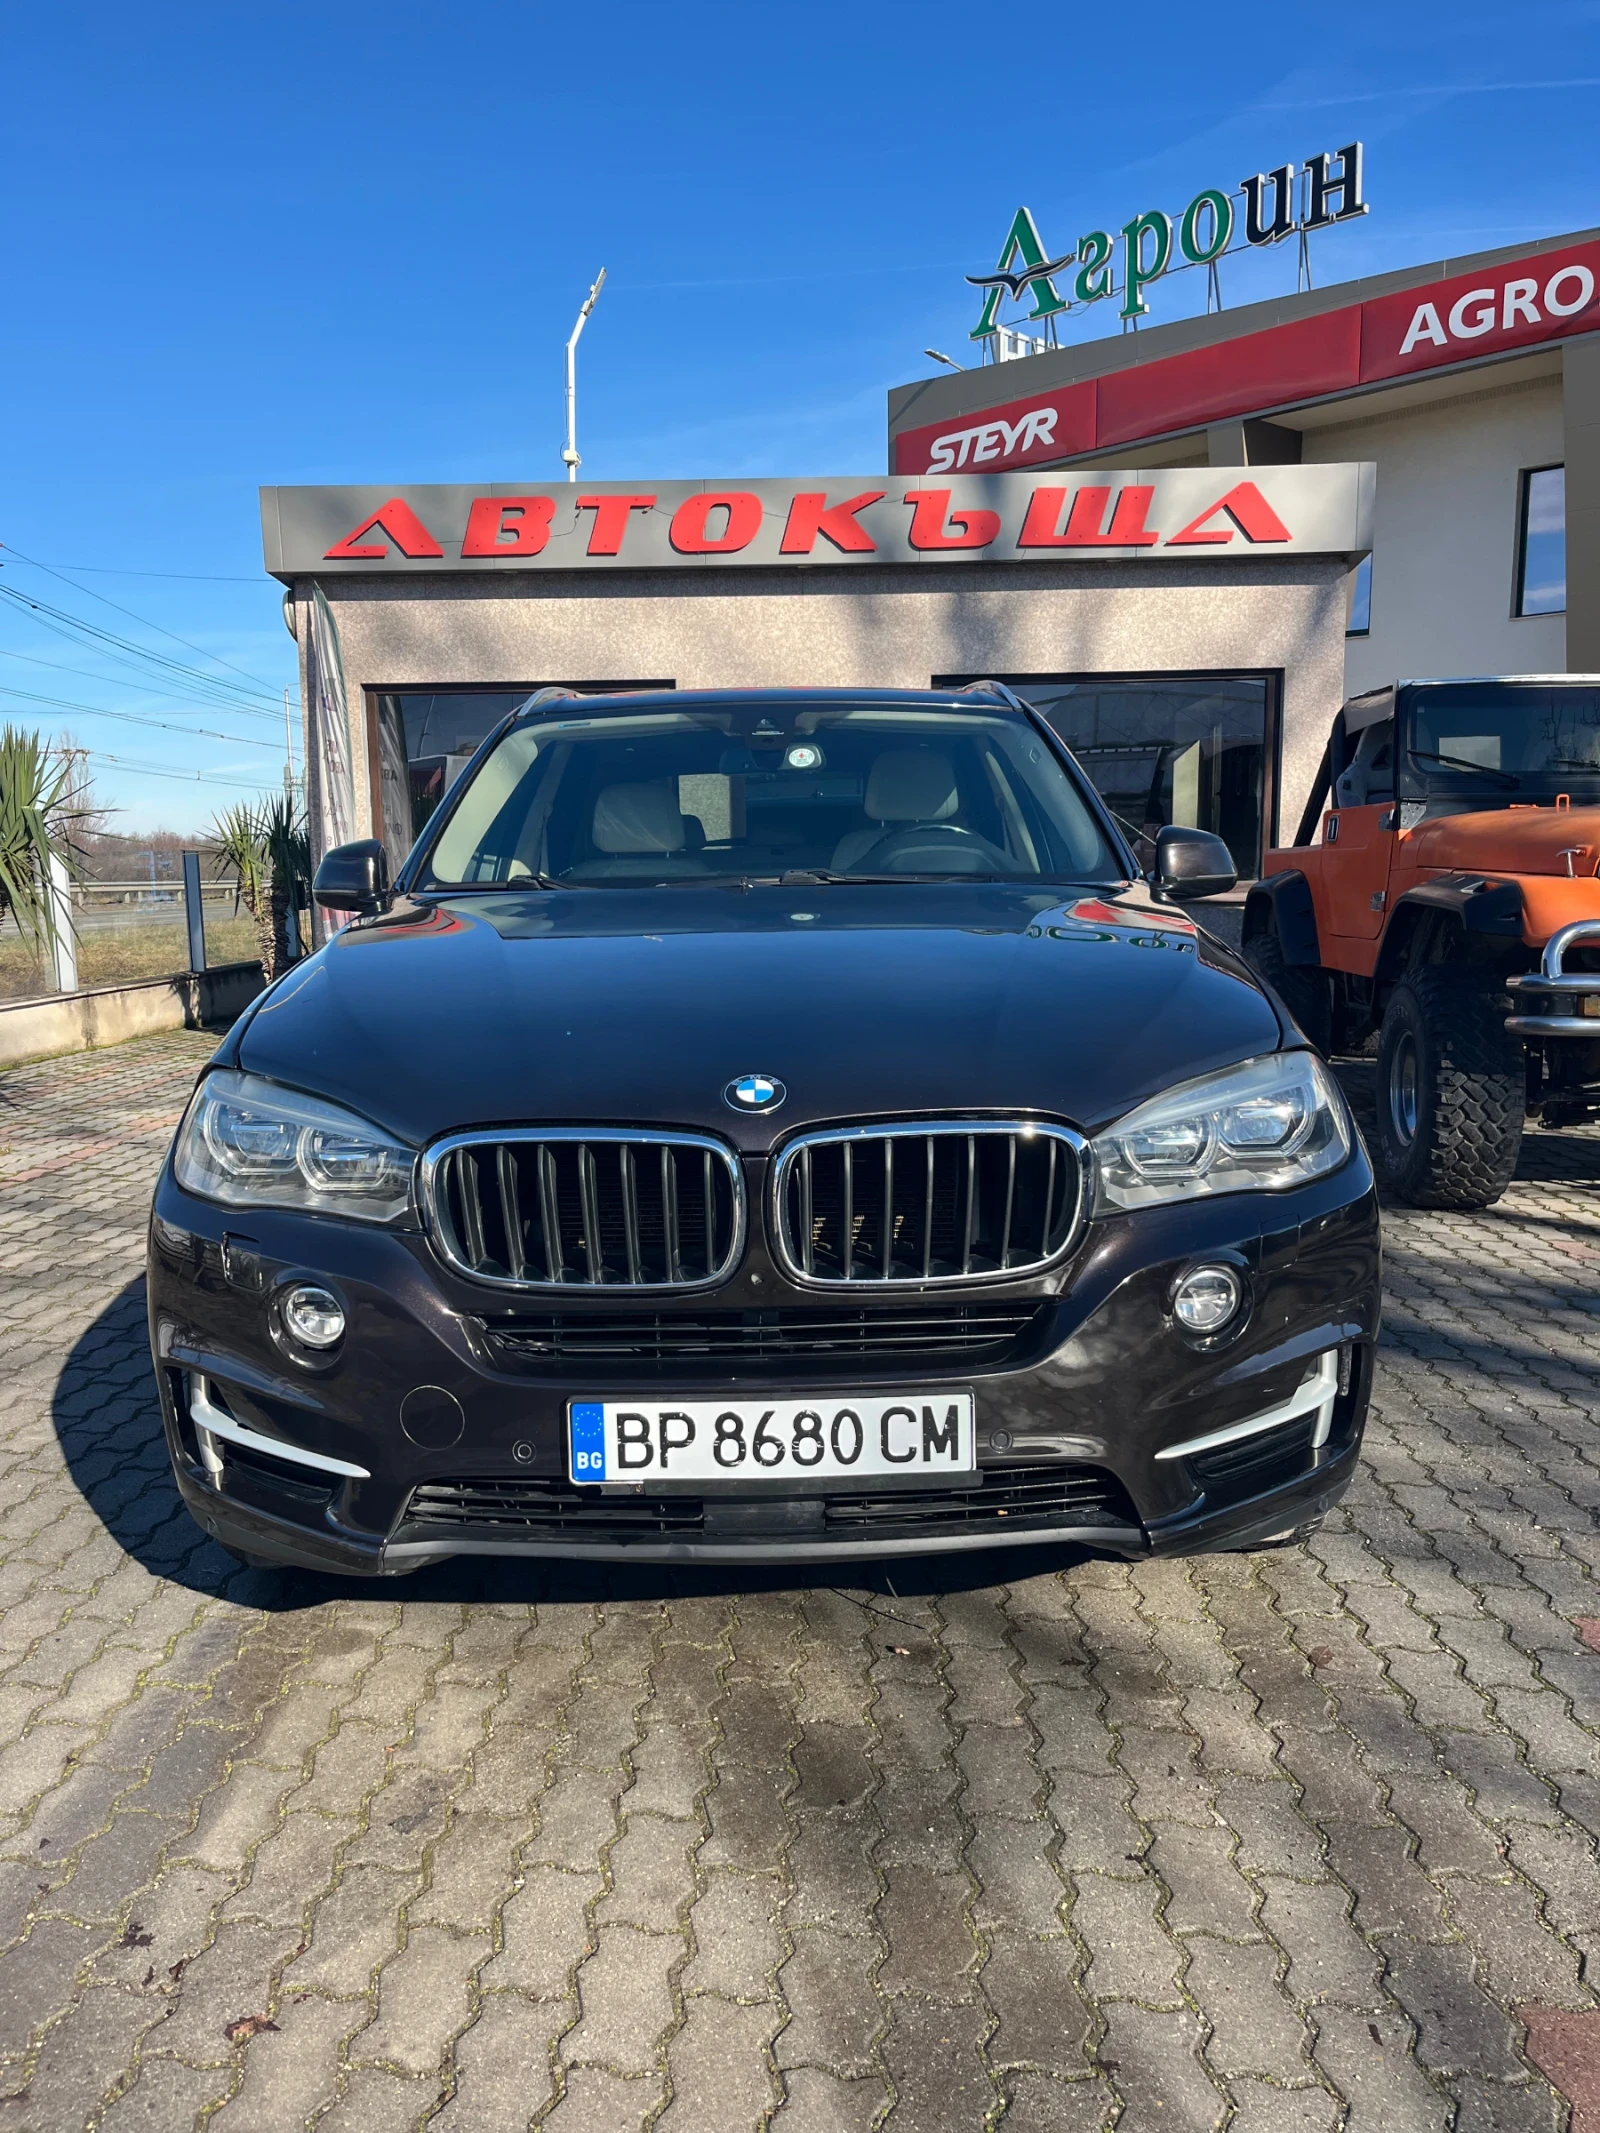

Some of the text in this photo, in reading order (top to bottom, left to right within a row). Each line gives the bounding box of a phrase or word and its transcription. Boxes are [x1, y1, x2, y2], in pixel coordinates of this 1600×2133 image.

[1398, 265, 1600, 356] AGRO
[925, 407, 1058, 475] STEYR
[577, 1451, 602, 1470] BG
[616, 1404, 959, 1469] BP 8680 CM
